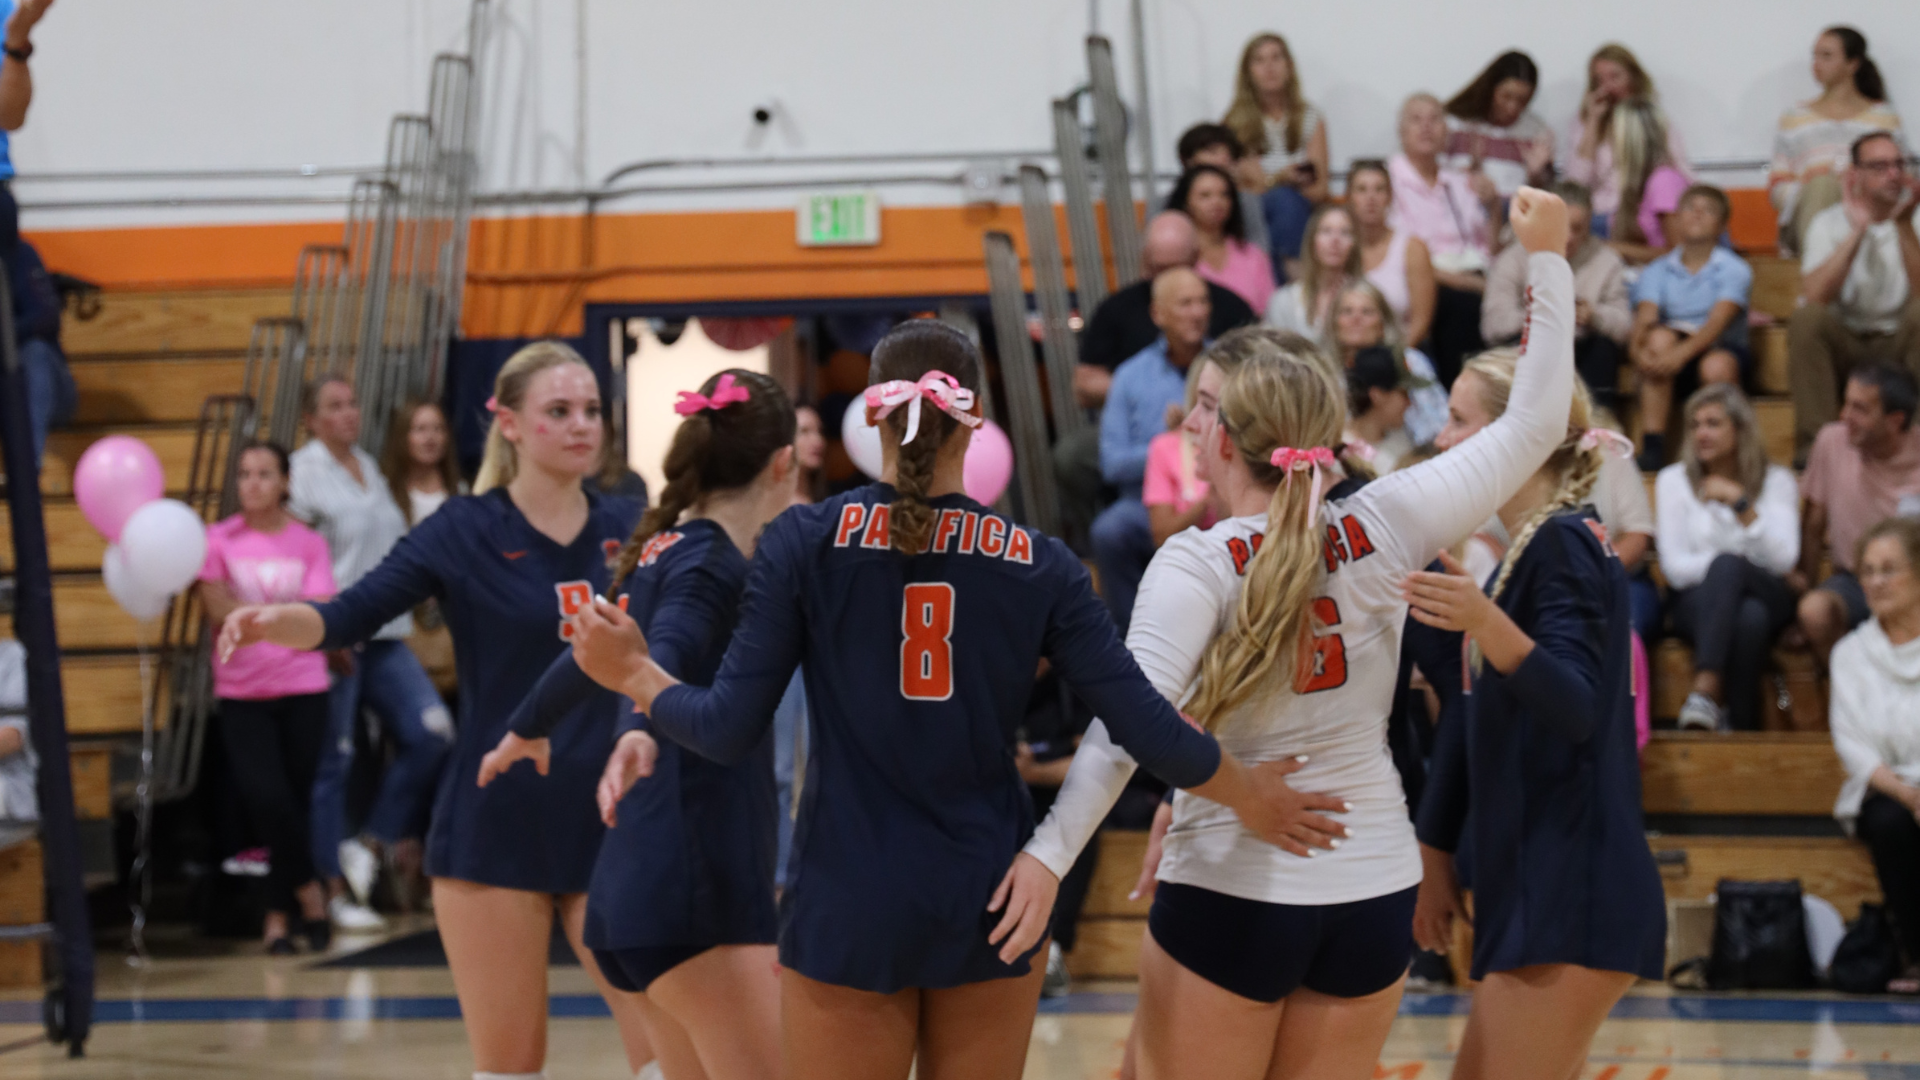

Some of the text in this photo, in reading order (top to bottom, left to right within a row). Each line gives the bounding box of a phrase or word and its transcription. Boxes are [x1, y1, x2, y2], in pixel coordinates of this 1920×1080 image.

[810, 195, 866, 242] EXIT
[834, 502, 1033, 565] PAFICA
[901, 582, 955, 701] 8
[1292, 596, 1348, 695] 6
